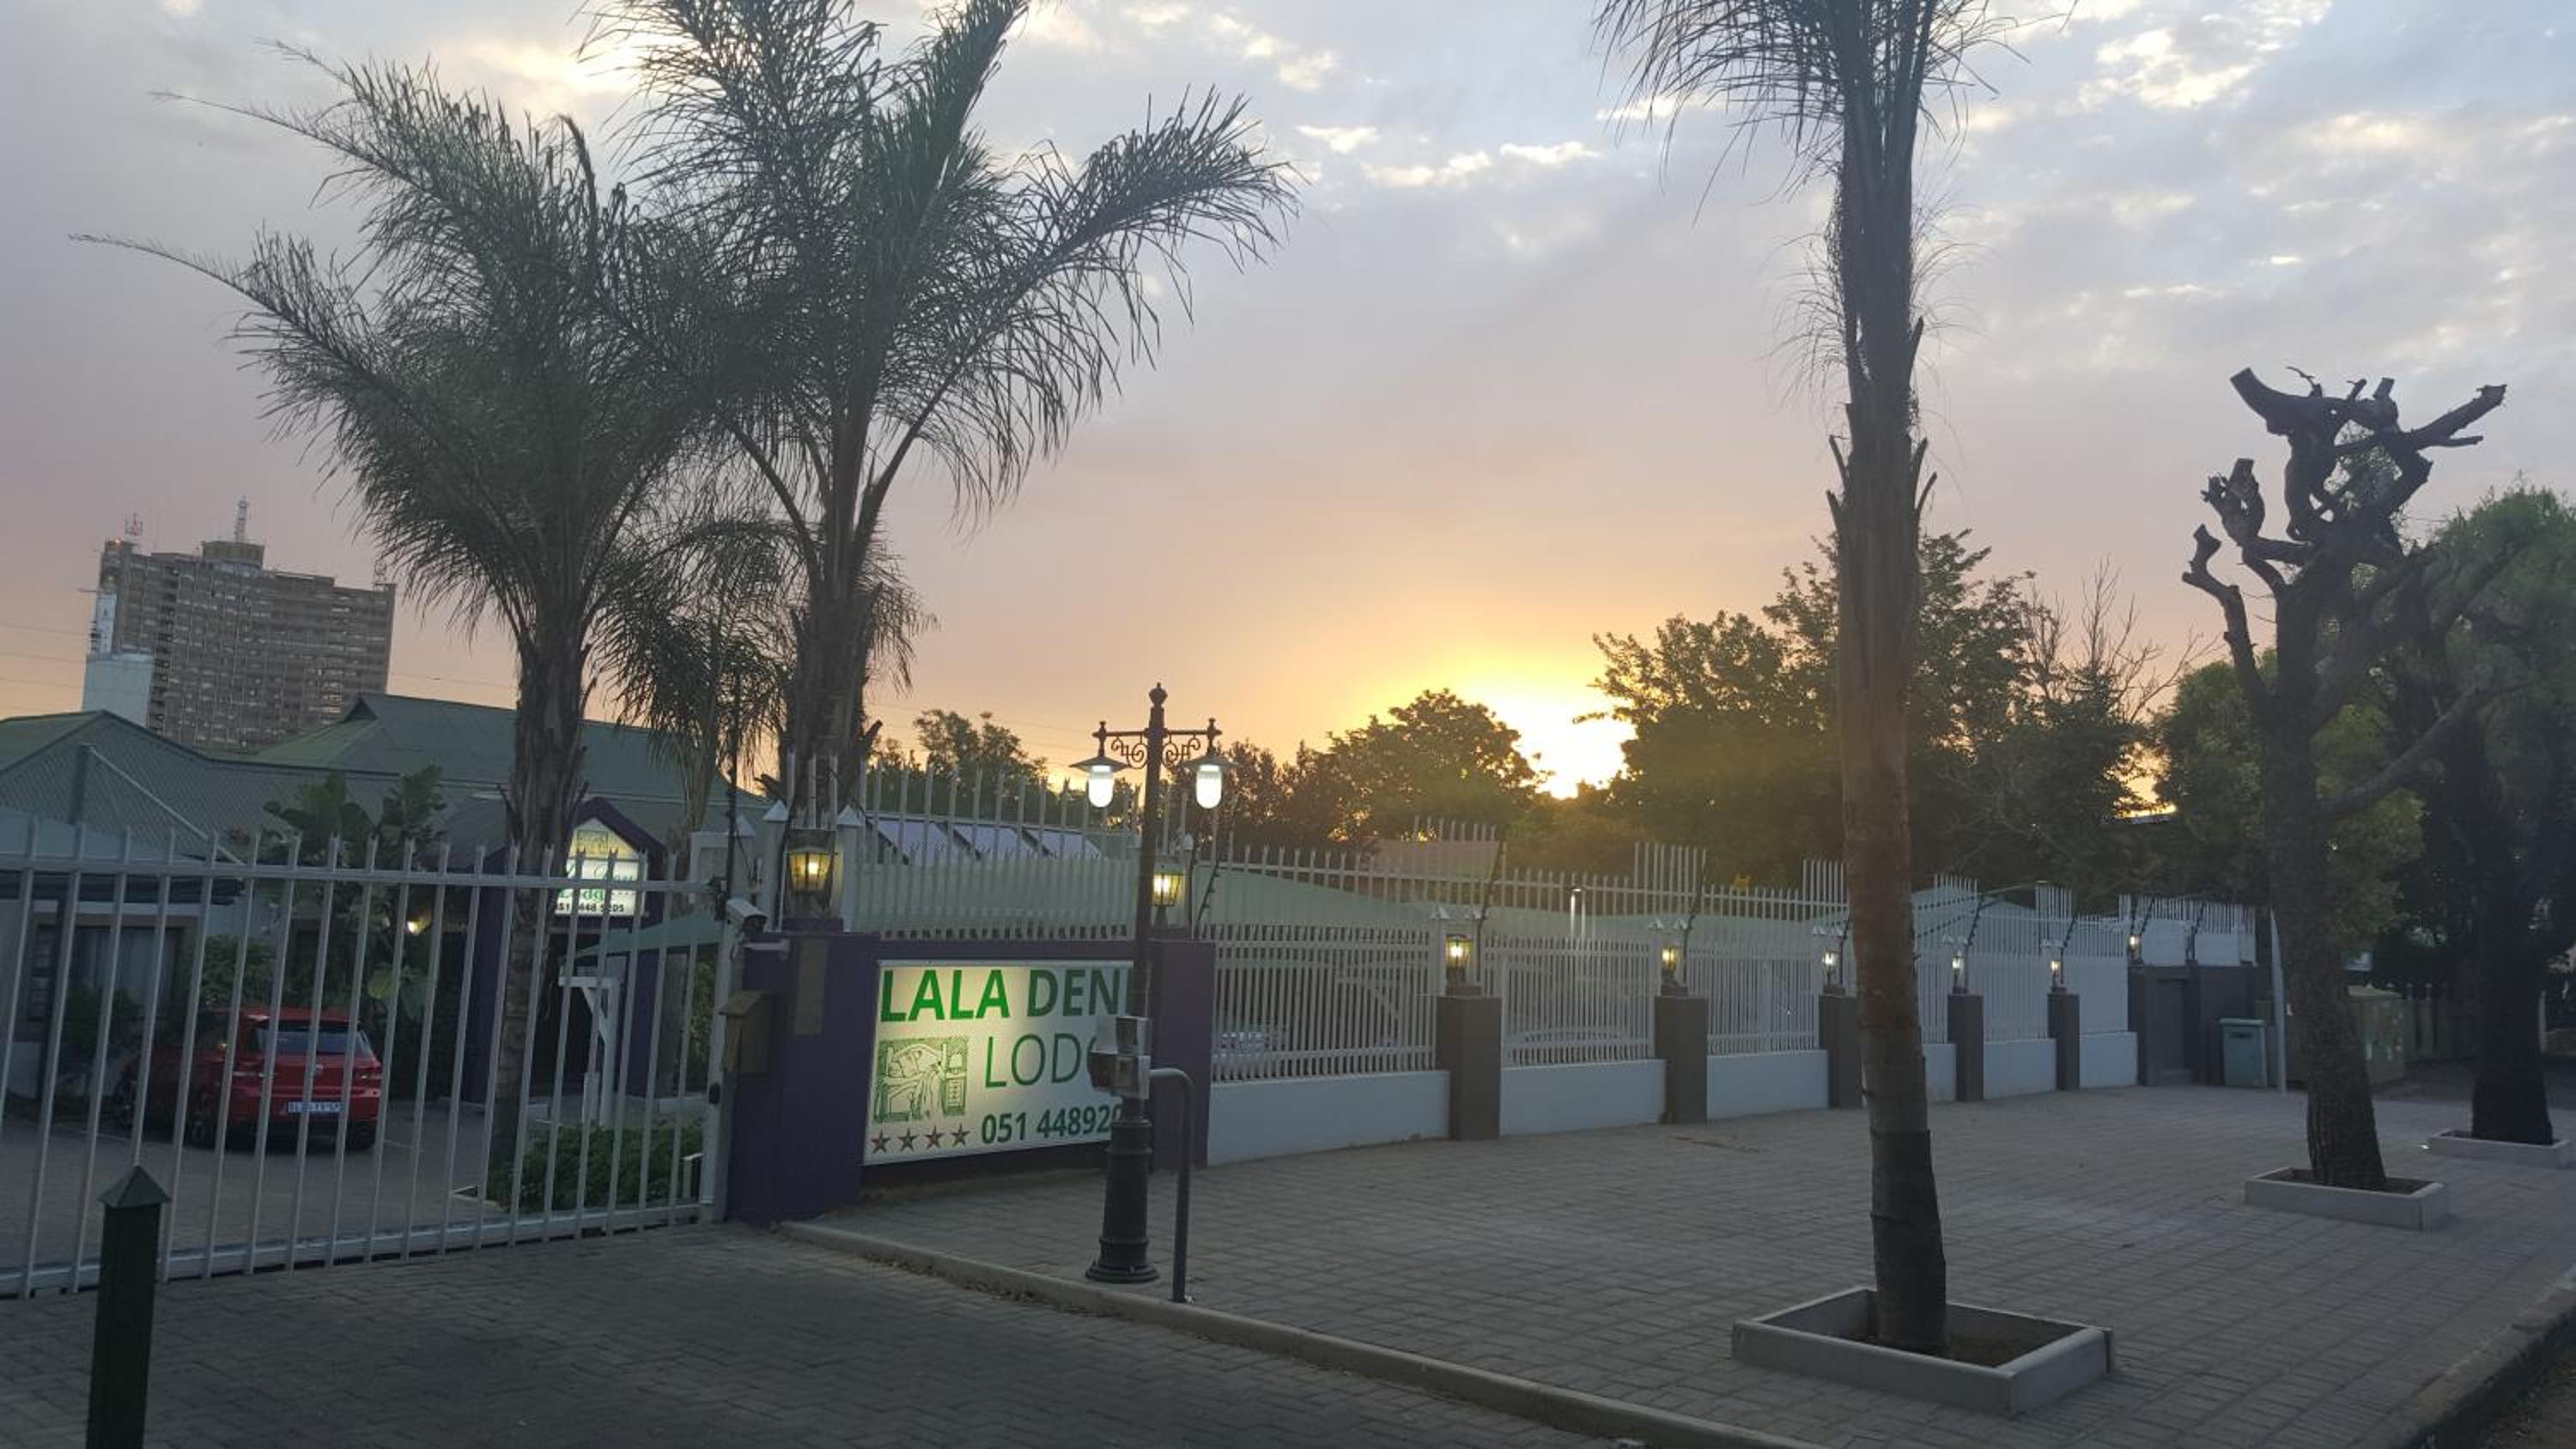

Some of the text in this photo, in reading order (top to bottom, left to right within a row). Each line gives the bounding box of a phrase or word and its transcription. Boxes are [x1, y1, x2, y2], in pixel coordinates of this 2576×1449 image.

[879, 969, 1011, 1023] LALA
[985, 1033, 1097, 1088] LOD
[981, 1112, 1027, 1143] 051
